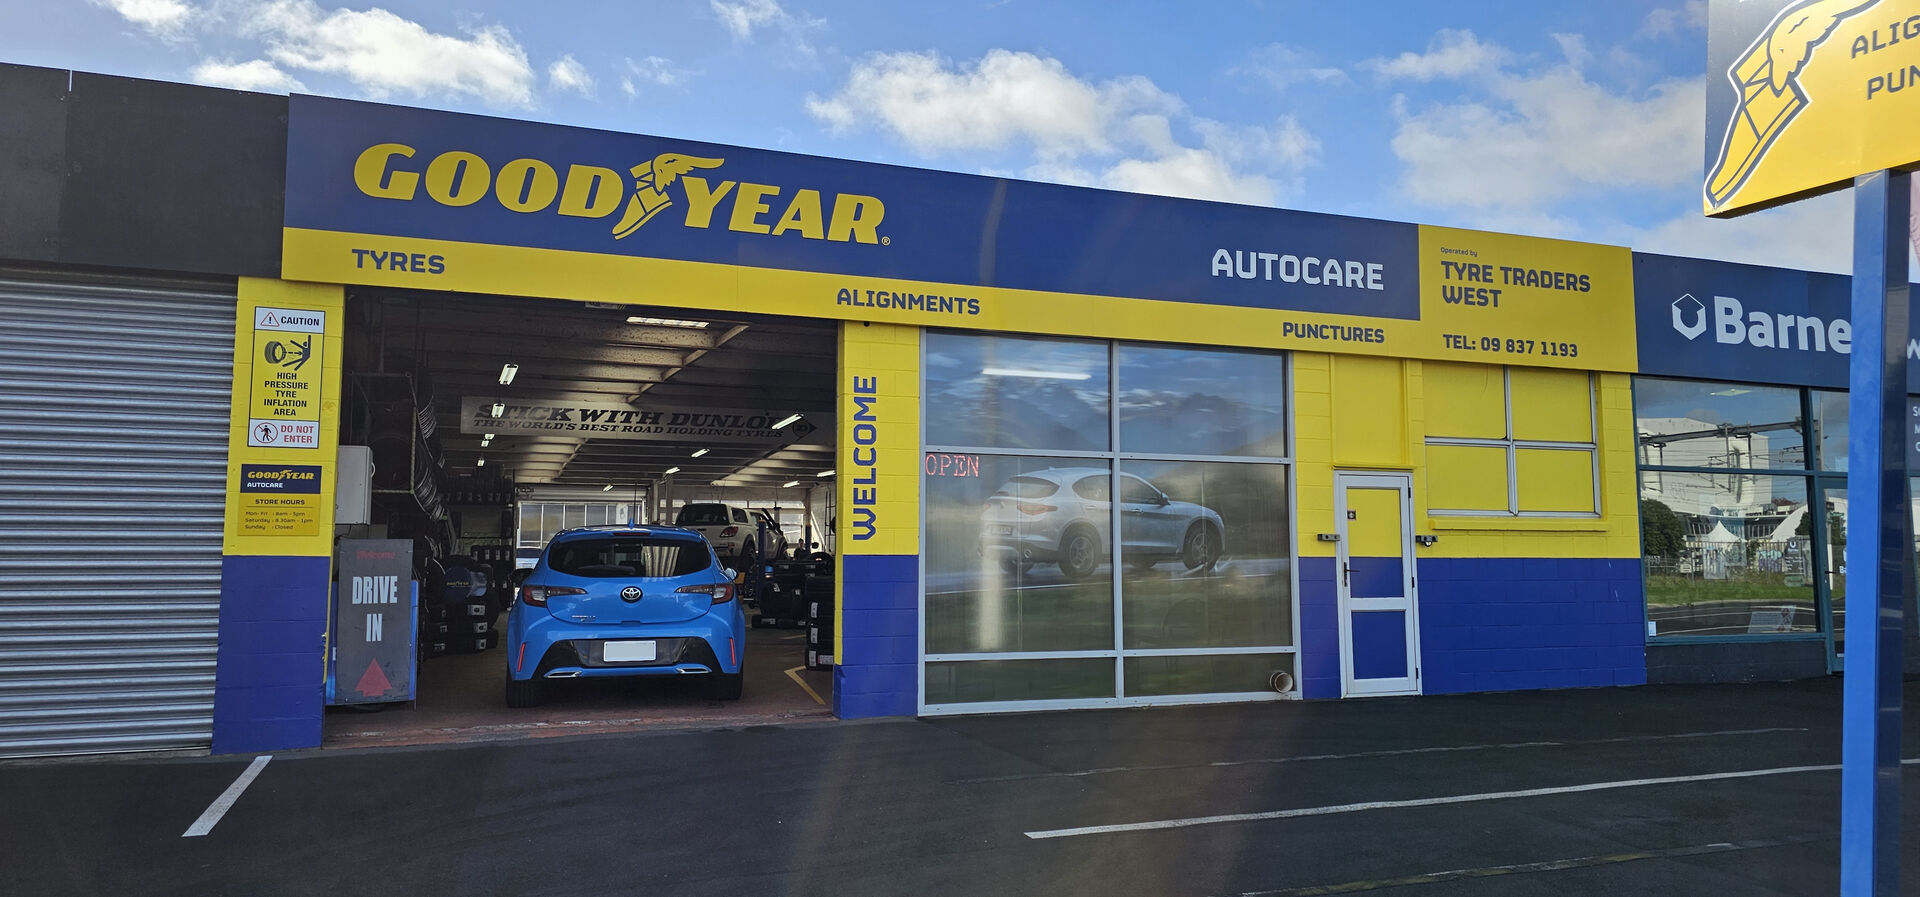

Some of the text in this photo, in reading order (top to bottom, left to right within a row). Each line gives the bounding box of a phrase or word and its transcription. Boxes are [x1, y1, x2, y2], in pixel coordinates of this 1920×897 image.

[1851, 14, 1920, 59] ALIG
[351, 248, 445, 275] TYRES
[1440, 247, 1478, 258] Operated by
[1212, 248, 1384, 291] AUTOCARE
[1441, 260, 1591, 293] TYRE TRADERS
[837, 287, 981, 315] ALIGNMENTS
[1442, 285, 1502, 308] WEST
[280, 316, 320, 326] CAUTION
[1282, 322, 1385, 344] PUNCTURES
[1442, 334, 1578, 358] TEL: 09 837 1193
[264, 380, 308, 390] PRESSURE
[276, 371, 297, 380] HIGH
[263, 398, 307, 408] INFLATION
[275, 389, 297, 398] TYRE
[273, 408, 296, 417] AREA
[578, 407, 665, 426] WITH
[280, 424, 314, 434] DO NOT
[473, 418, 505, 428] THE
[508, 420, 577, 431] WORLD'S
[579, 423, 619, 433] BEST
[621, 425, 663, 434] ROAD
[666, 427, 734, 437] HOLDING
[283, 435, 313, 443] ENTER
[853, 376, 877, 541] WELCOME
[925, 454, 980, 477] OPEN
[352, 575, 398, 604] DRIVE
[366, 613, 382, 642] IN
